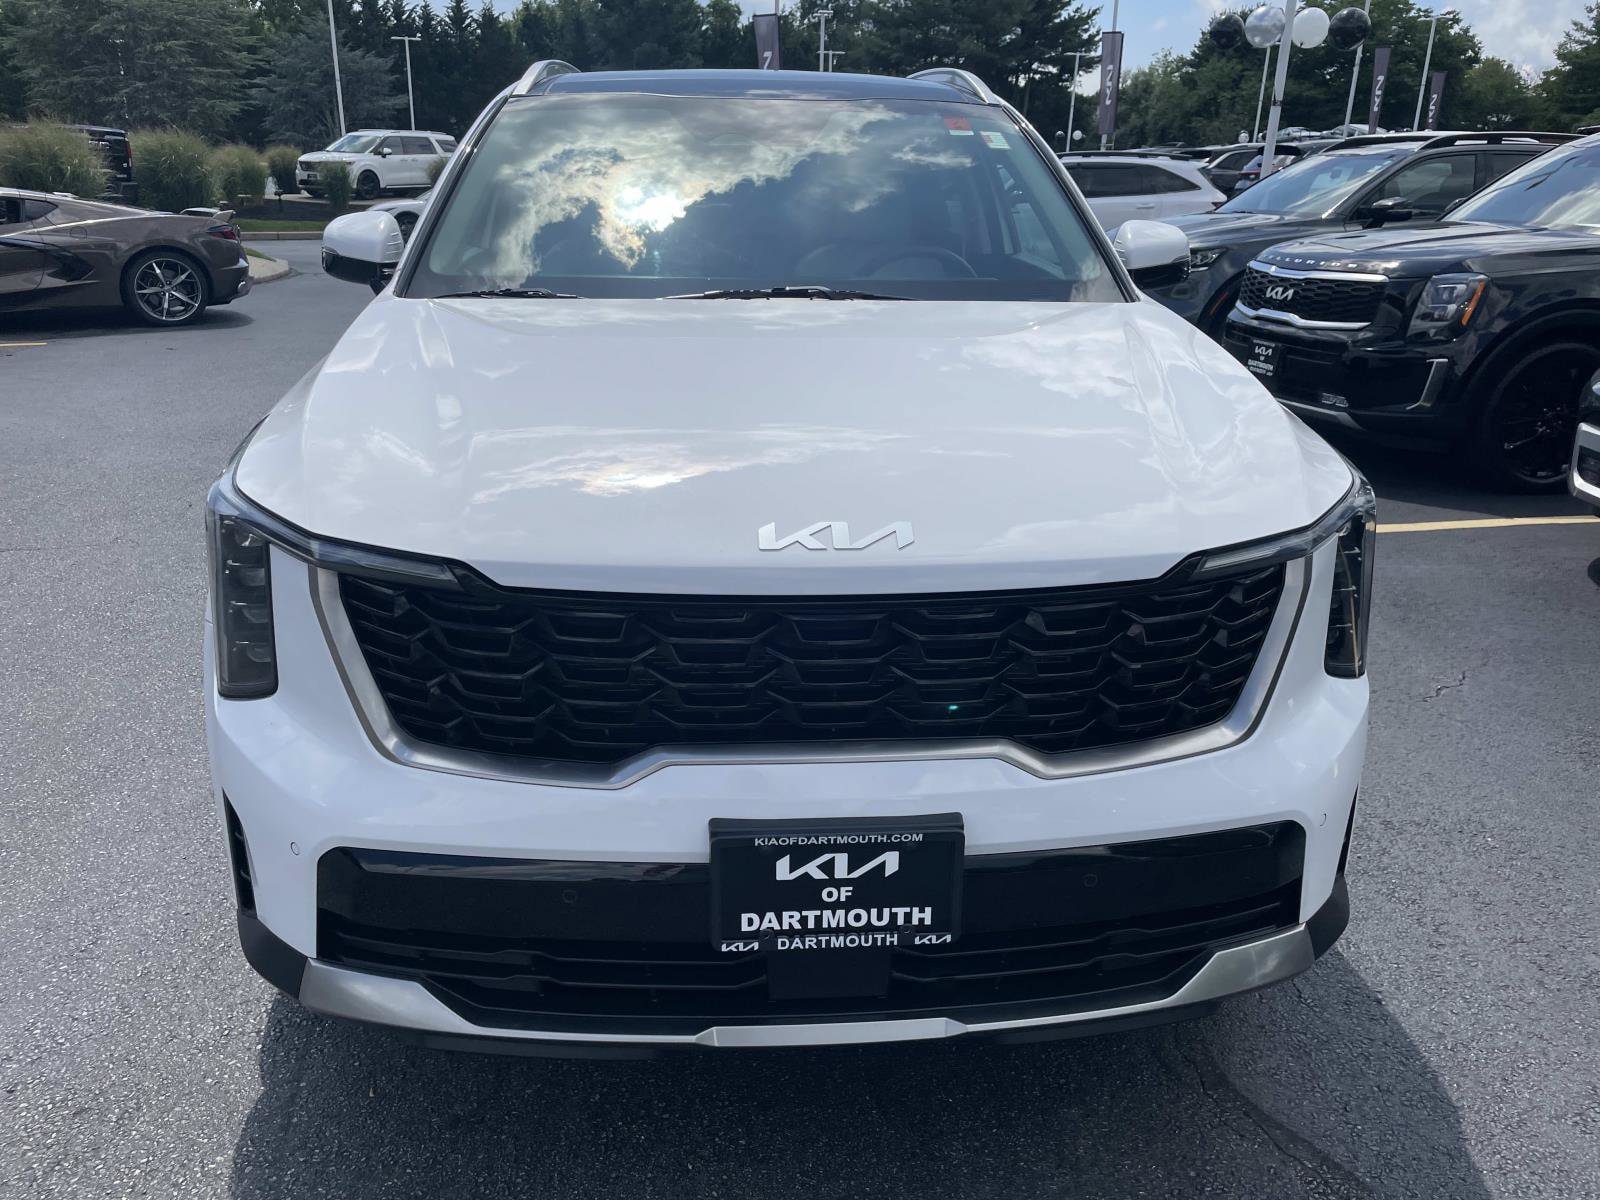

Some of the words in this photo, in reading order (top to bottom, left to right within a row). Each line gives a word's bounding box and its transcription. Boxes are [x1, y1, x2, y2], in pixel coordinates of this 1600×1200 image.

[1265, 285, 1295, 301] KIA
[758, 521, 915, 551] KIA
[754, 833, 924, 847] KIAOFDARTMOUTH.COM
[775, 850, 900, 881] KIA
[821, 886, 853, 902] OF
[740, 906, 932, 932] DARTMOUTH
[721, 941, 759, 952] KIA
[777, 933, 898, 951] DARTMOUTH
[914, 934, 952, 945] KIA
